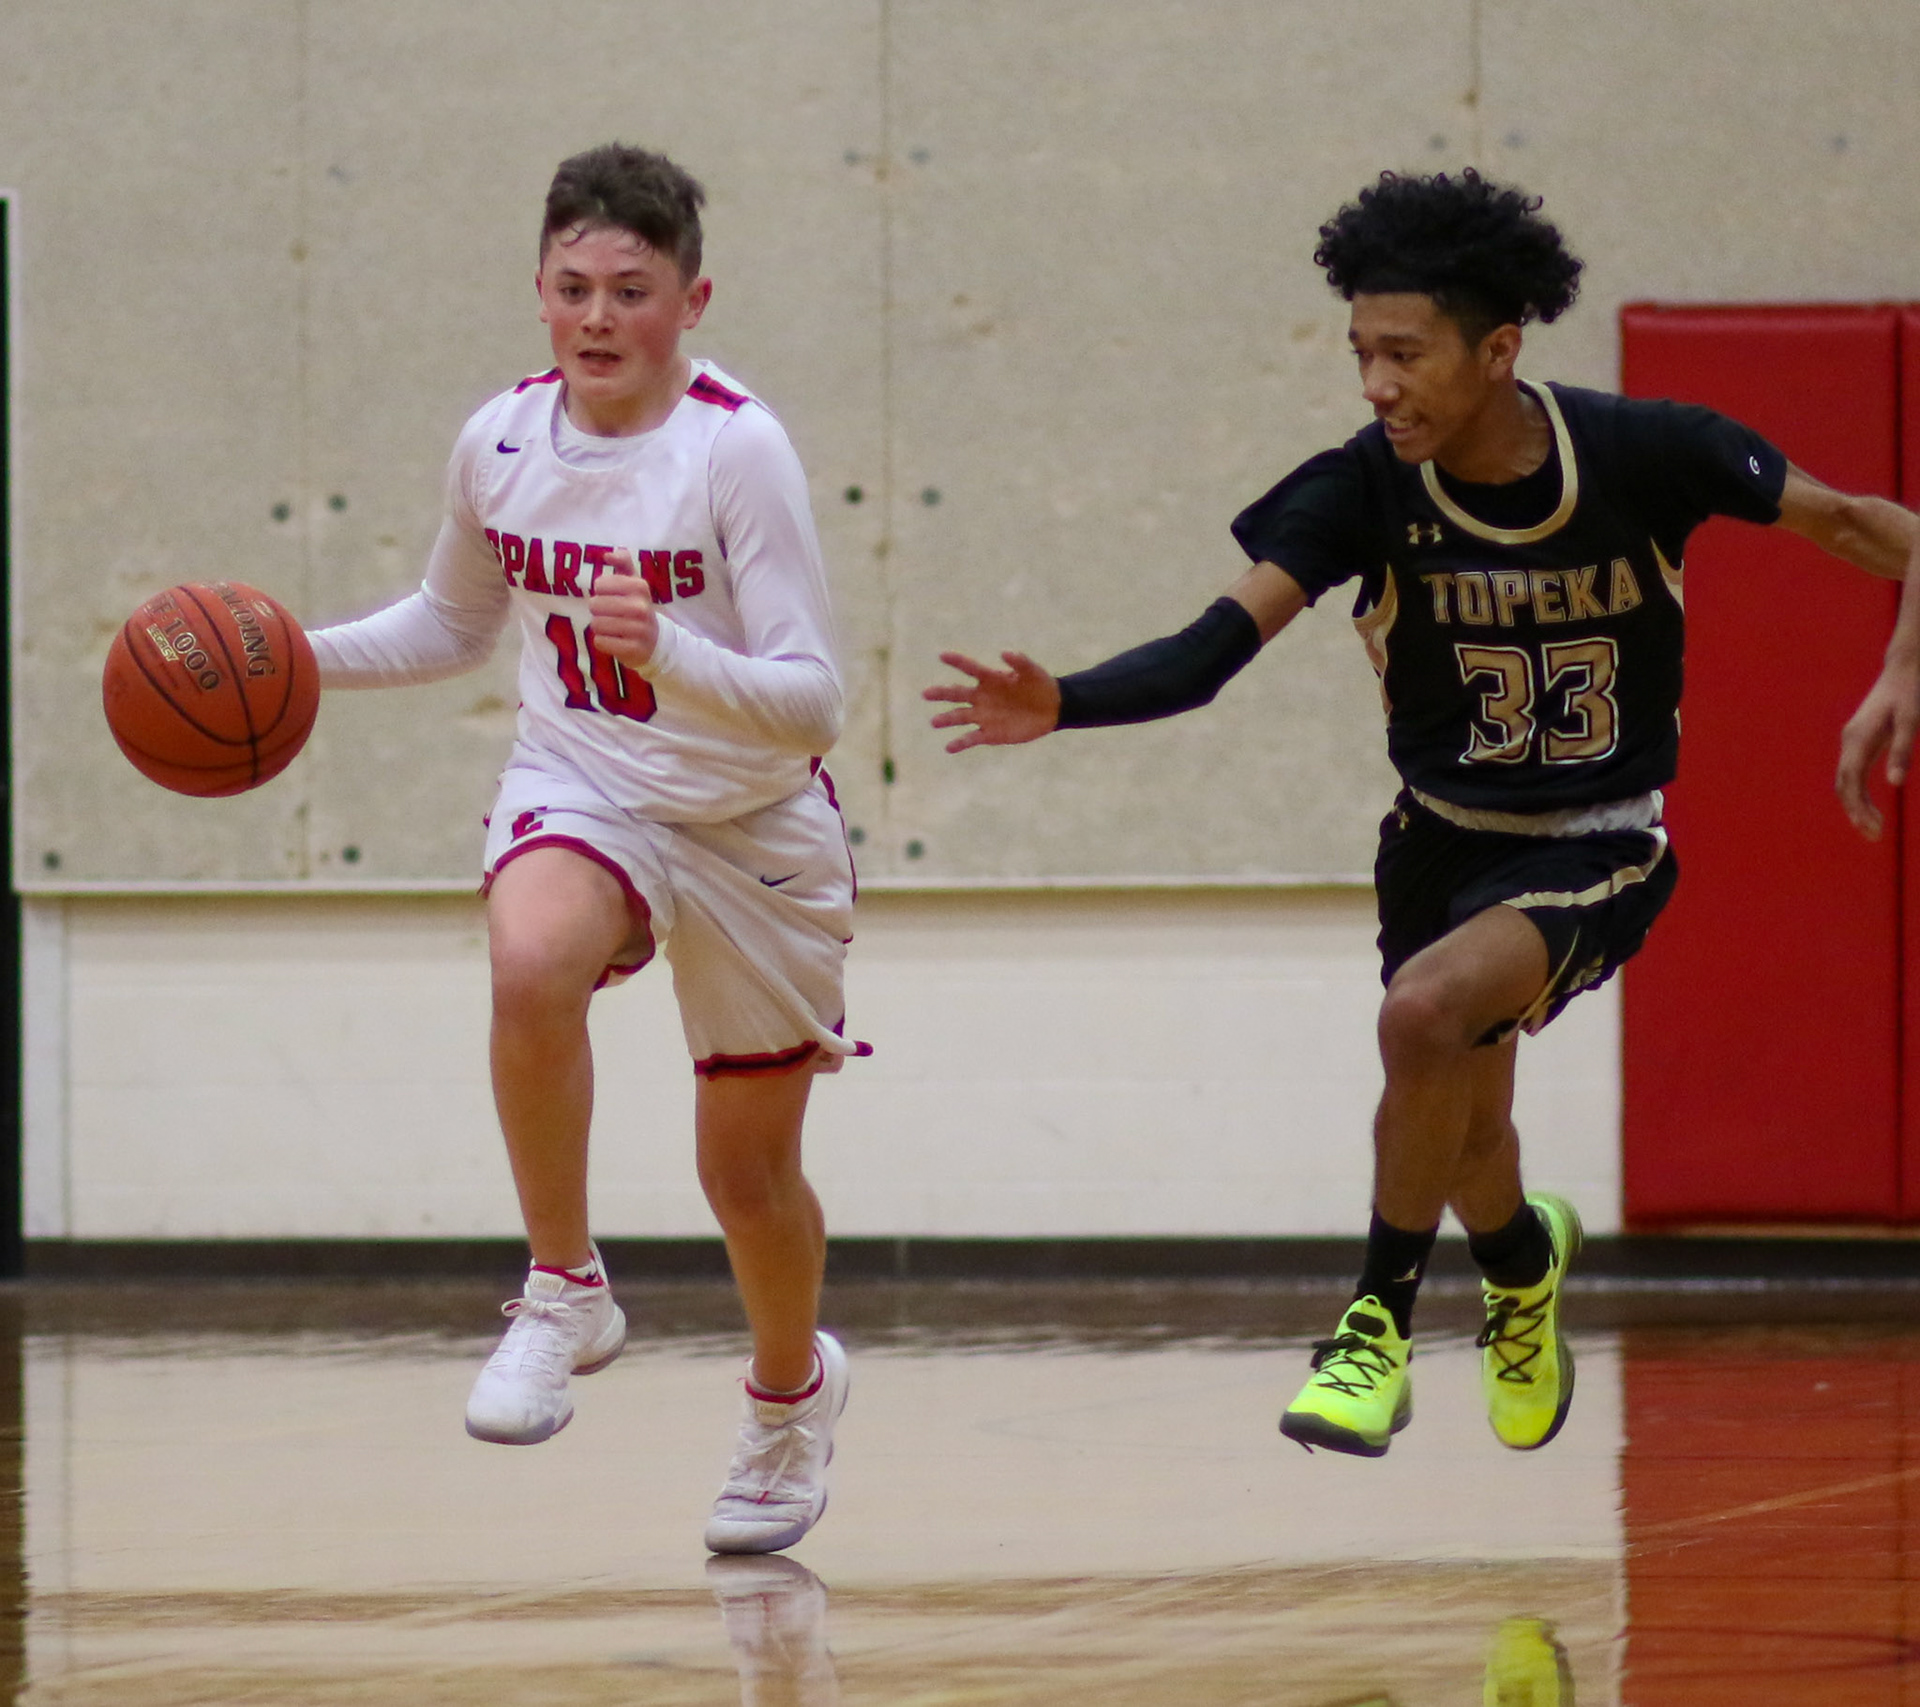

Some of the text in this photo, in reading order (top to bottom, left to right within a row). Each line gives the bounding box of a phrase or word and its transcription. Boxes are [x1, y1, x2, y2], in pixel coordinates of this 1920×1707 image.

[484, 527, 705, 604] PARTNS
[1419, 556, 1643, 627] TOPEKA
[545, 612, 657, 722] 10
[1453, 636, 1619, 765] 33
